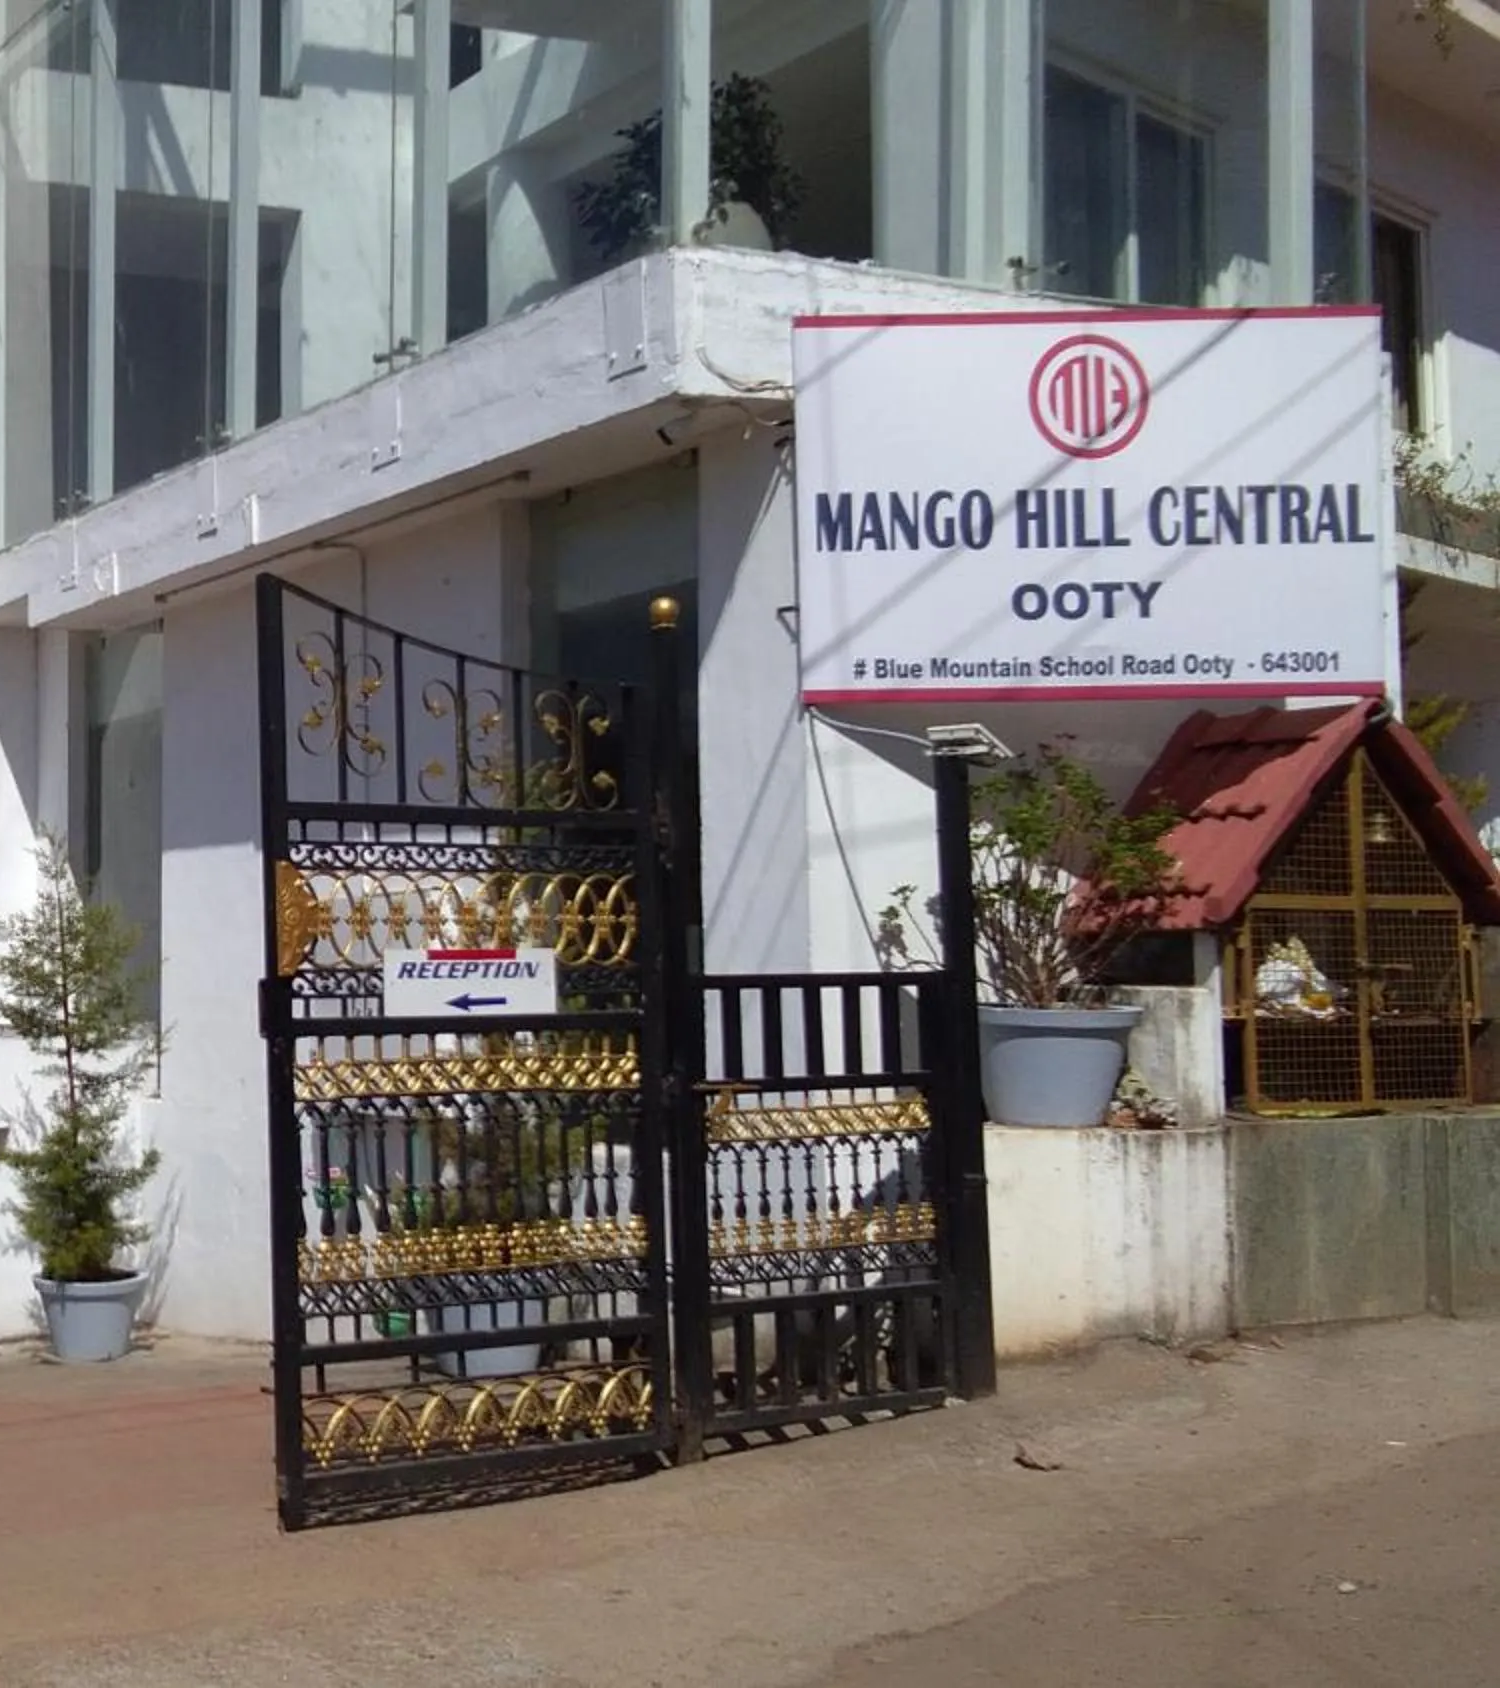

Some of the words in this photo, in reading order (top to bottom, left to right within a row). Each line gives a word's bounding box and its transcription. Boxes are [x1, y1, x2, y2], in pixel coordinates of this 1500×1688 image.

[815, 489, 994, 553] MANGO
[1015, 488, 1131, 548] HILL
[1149, 483, 1375, 546] CENTRAL
[1012, 581, 1163, 621] OOTY
[874, 658, 924, 679] Blue
[931, 656, 1032, 678] Mountain
[1039, 655, 1115, 677] School
[1121, 654, 1176, 676] Road
[1183, 653, 1235, 679] Ooty
[1261, 651, 1340, 673] 643001
[397, 961, 540, 979] RECEPTION
